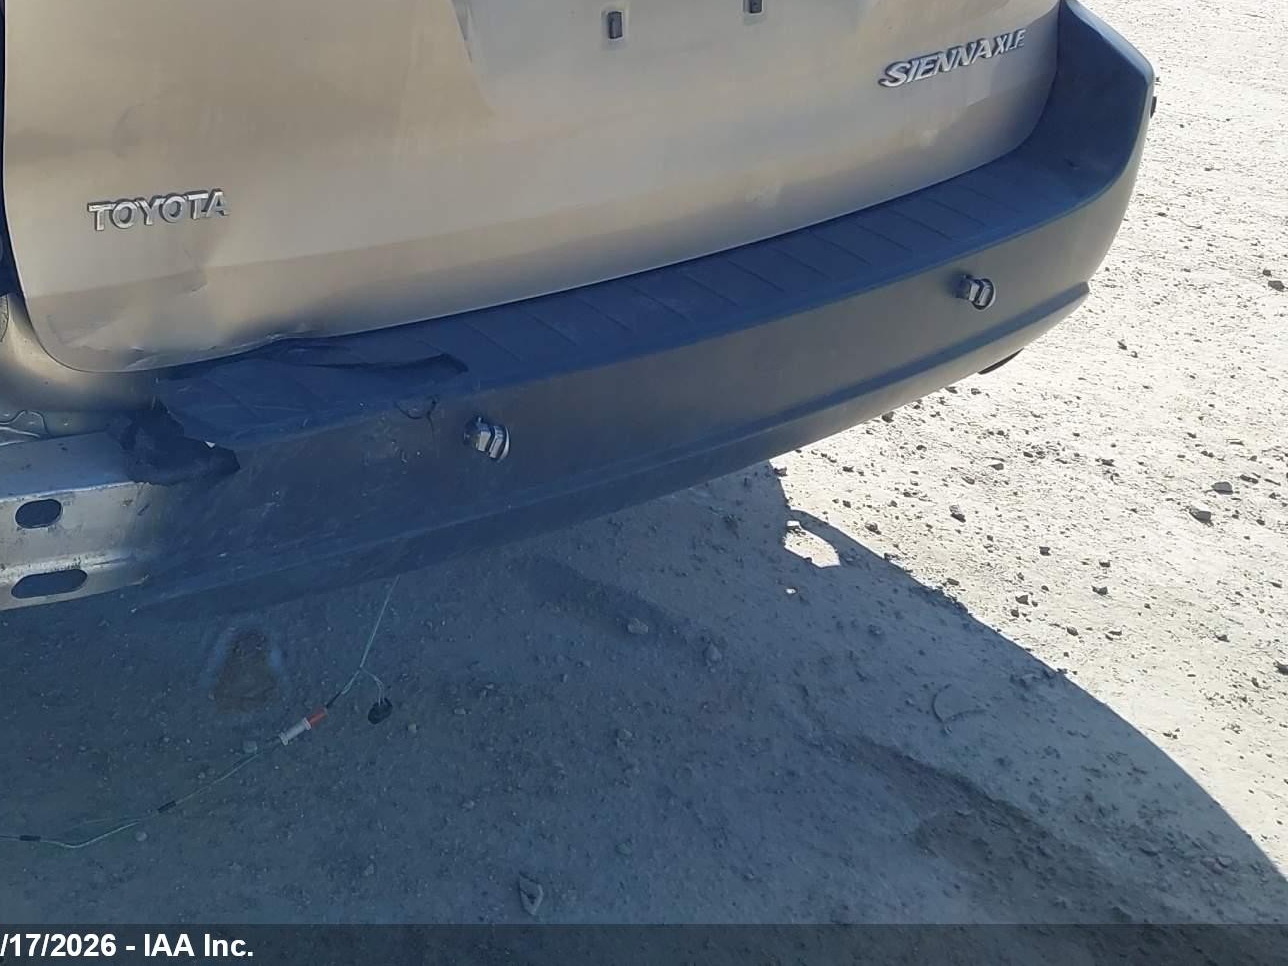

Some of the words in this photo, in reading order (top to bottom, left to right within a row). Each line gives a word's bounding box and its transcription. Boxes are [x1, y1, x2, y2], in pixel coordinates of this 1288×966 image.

[878, 37, 993, 87] SIENNA
[993, 29, 1027, 57] XLE
[87, 188, 230, 231] TOYOTA
